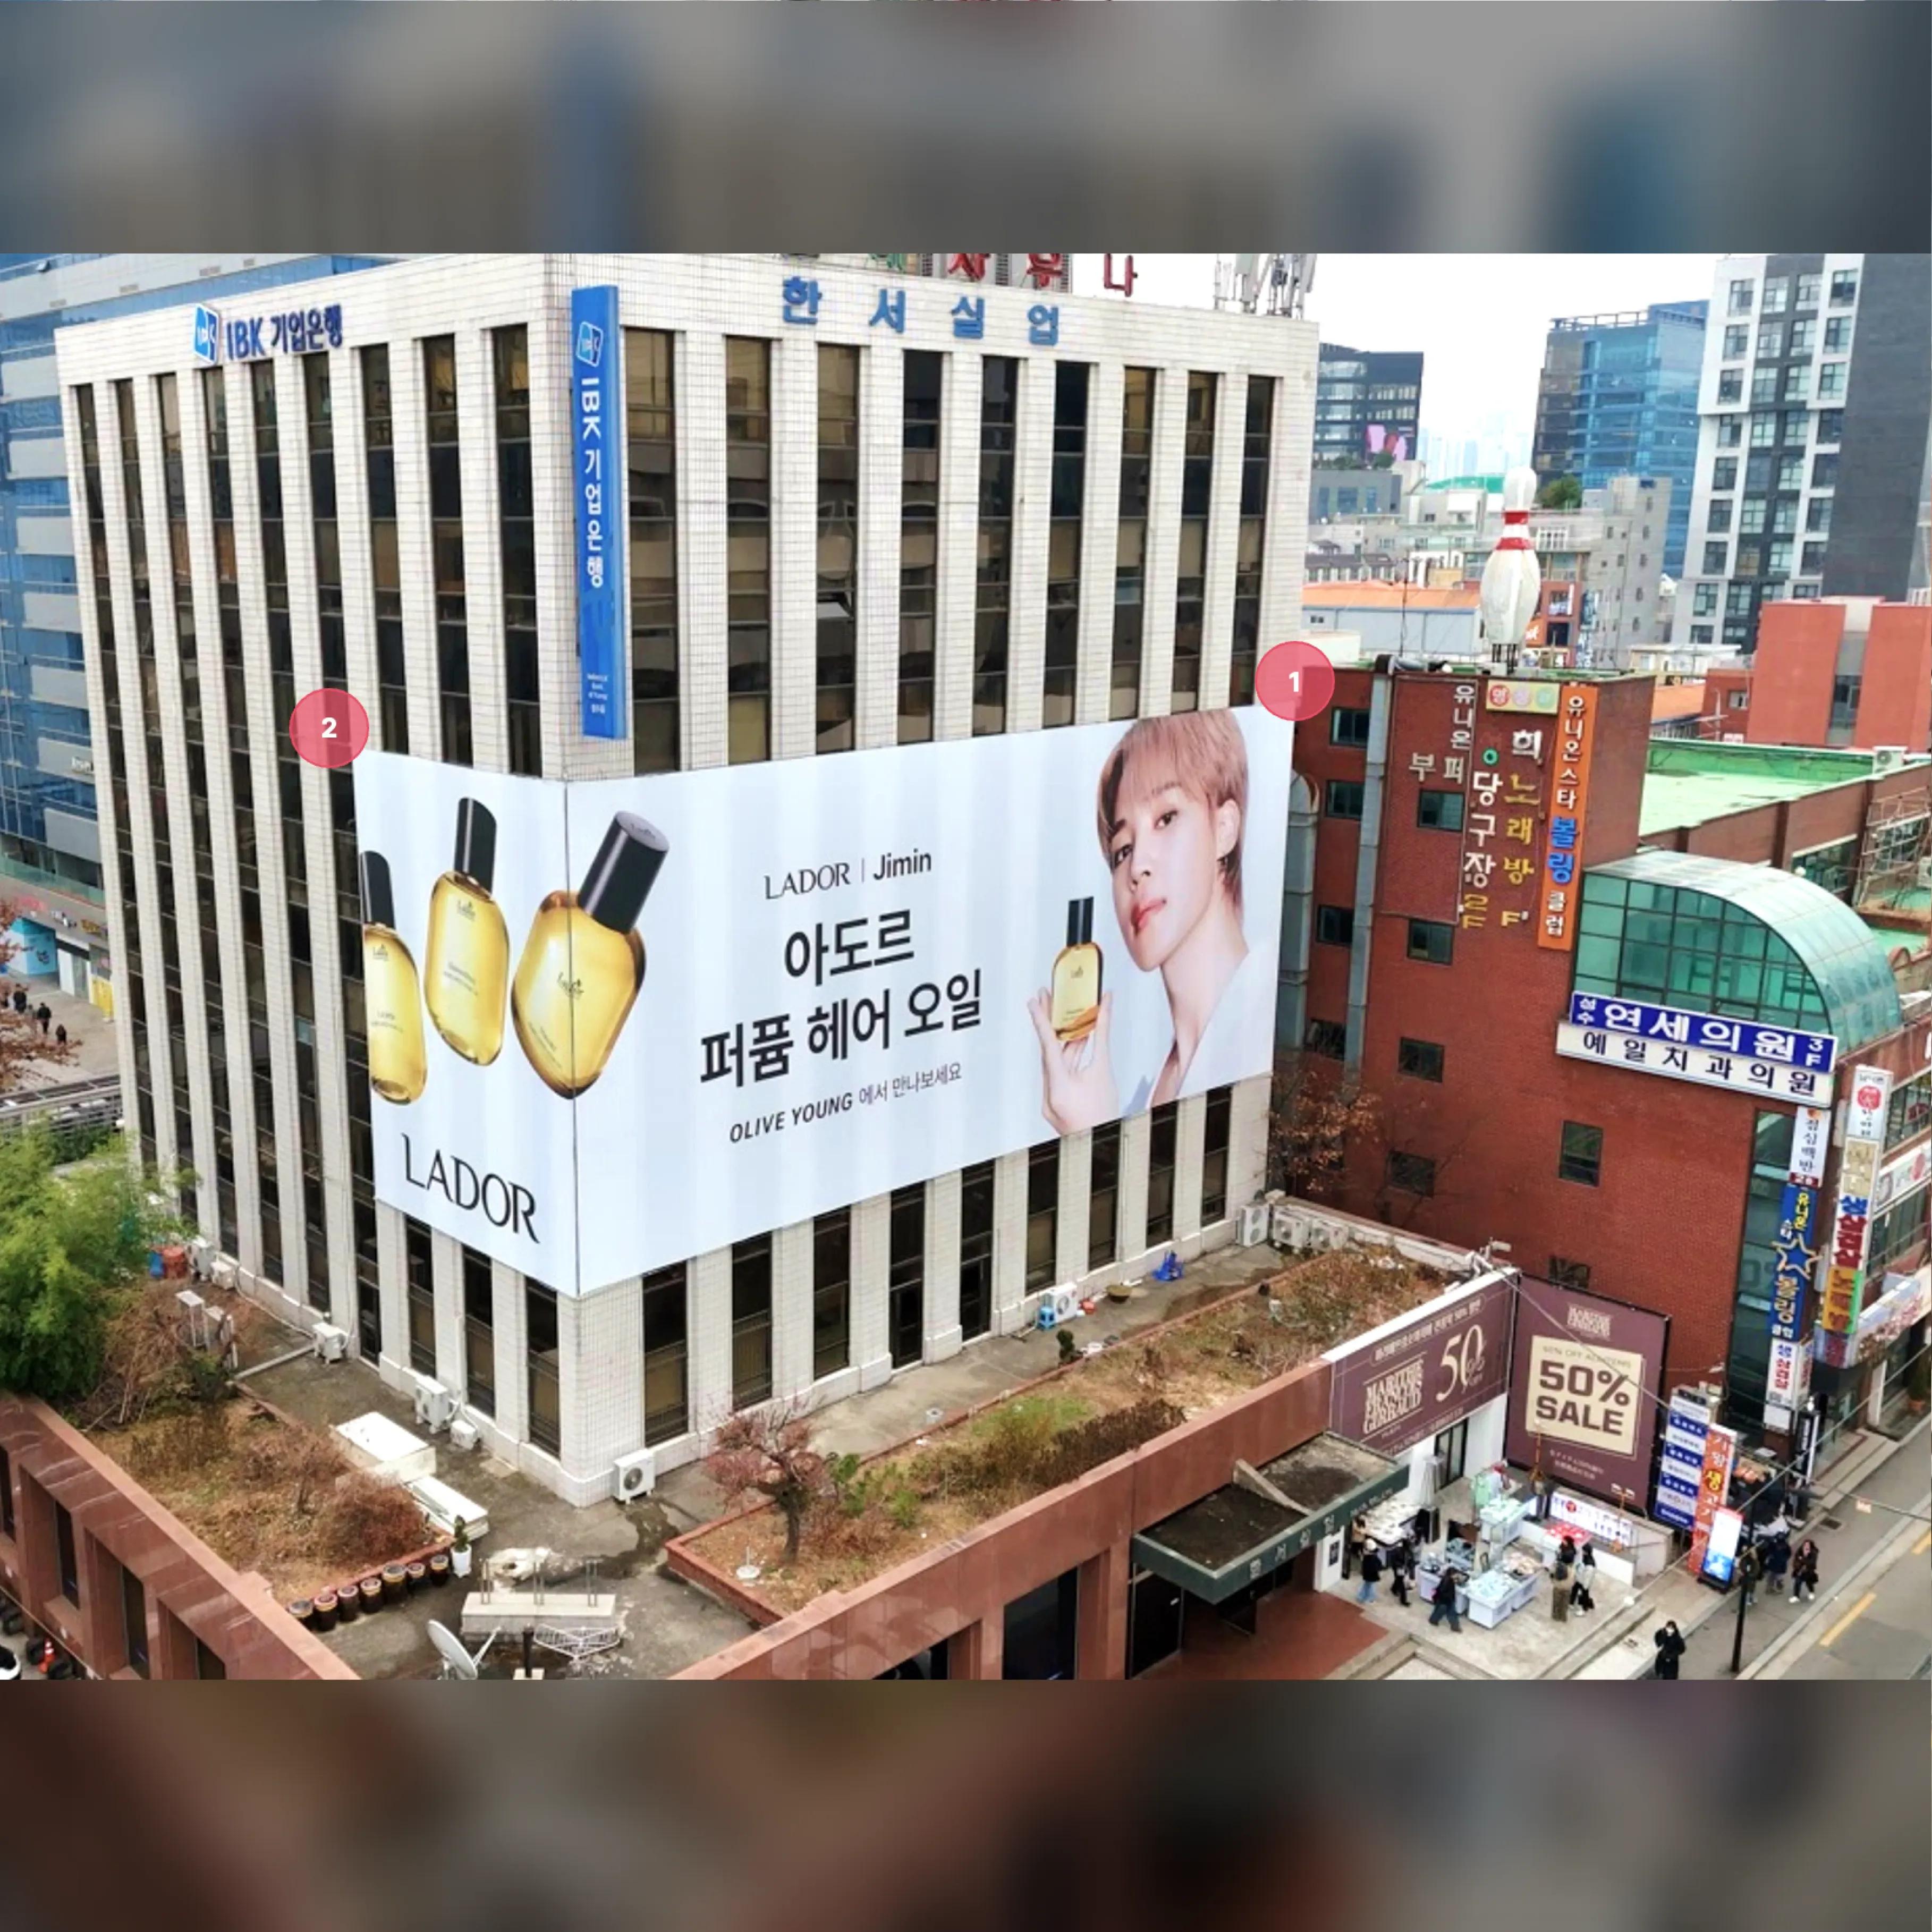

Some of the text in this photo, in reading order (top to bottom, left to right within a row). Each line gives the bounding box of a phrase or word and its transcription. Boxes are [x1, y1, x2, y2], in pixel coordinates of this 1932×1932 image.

[227, 303, 343, 361] IBK 기업은행
[782, 276, 1059, 346] 한서실업
[581, 378, 604, 589] IBK 기업은행
[1450, 685, 1476, 750] 유니온
[1463, 770, 1504, 888] 당구장
[1503, 774, 1541, 885] 노래방
[1548, 817, 1581, 884] 볼링
[764, 848, 932, 900] LADOR Jimin
[784, 909, 914, 986] 아도르
[700, 968, 981, 1088] 퍼퓸 헤어 오일
[1604, 1005, 1795, 1062] 연세의원
[1583, 1031, 1816, 1097] 예일치과의원
[730, 1061, 962, 1143] OLIVE YOUNG 에서 만나보세요
[401, 1132, 540, 1244] LADOR
[1536, 1395, 1624, 1436] SALE
[1540, 1359, 1631, 1407] 50%
